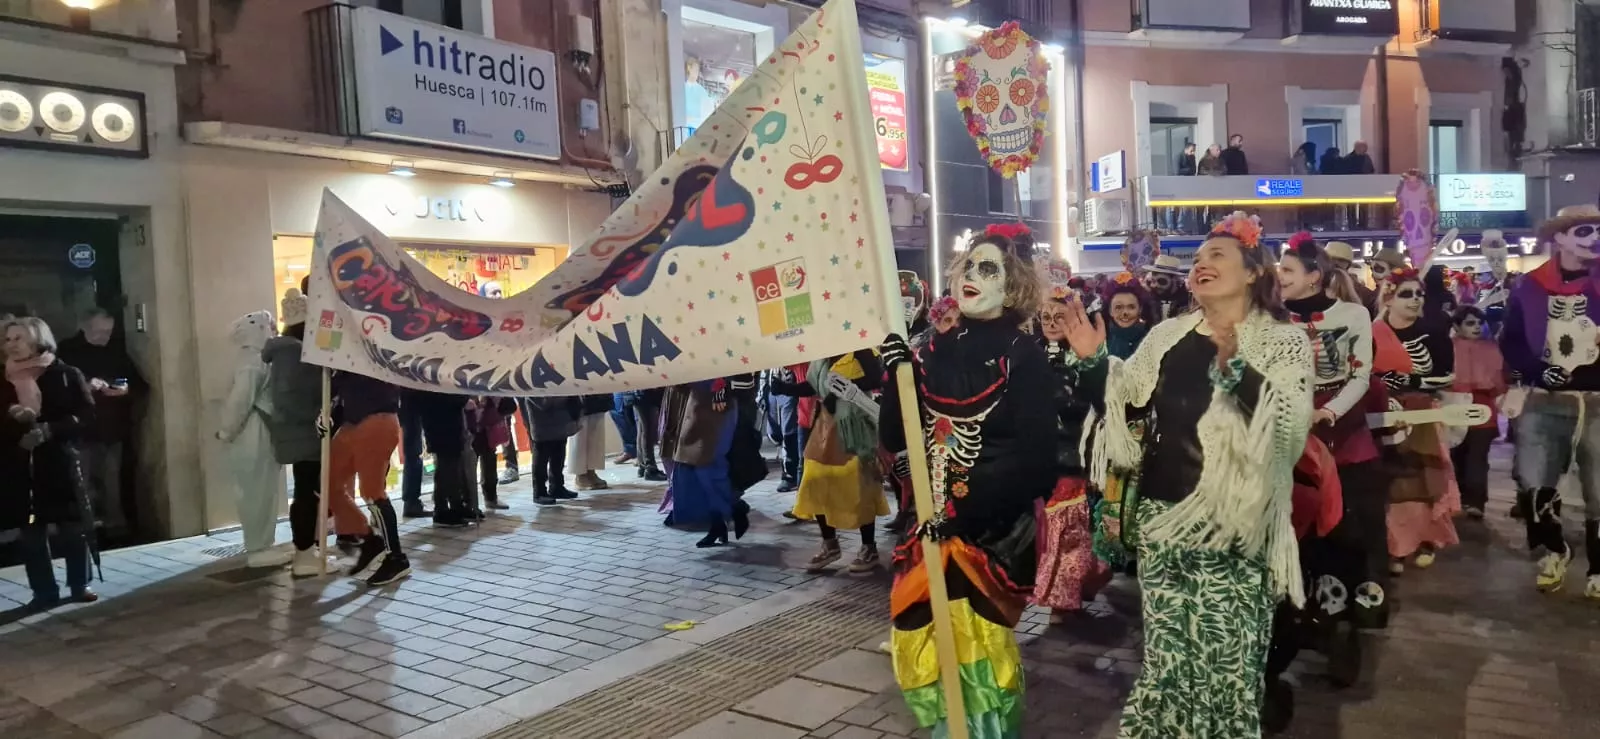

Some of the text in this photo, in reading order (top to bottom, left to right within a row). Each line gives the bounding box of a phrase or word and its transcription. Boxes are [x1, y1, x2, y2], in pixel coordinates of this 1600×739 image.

[413, 29, 546, 90] hitradio
[415, 73, 475, 100] Huesca
[491, 89, 547, 114] 107.1fm
[1271, 180, 1301, 189] REALE
[755, 282, 779, 301] ce
[572, 313, 683, 380] ANA
